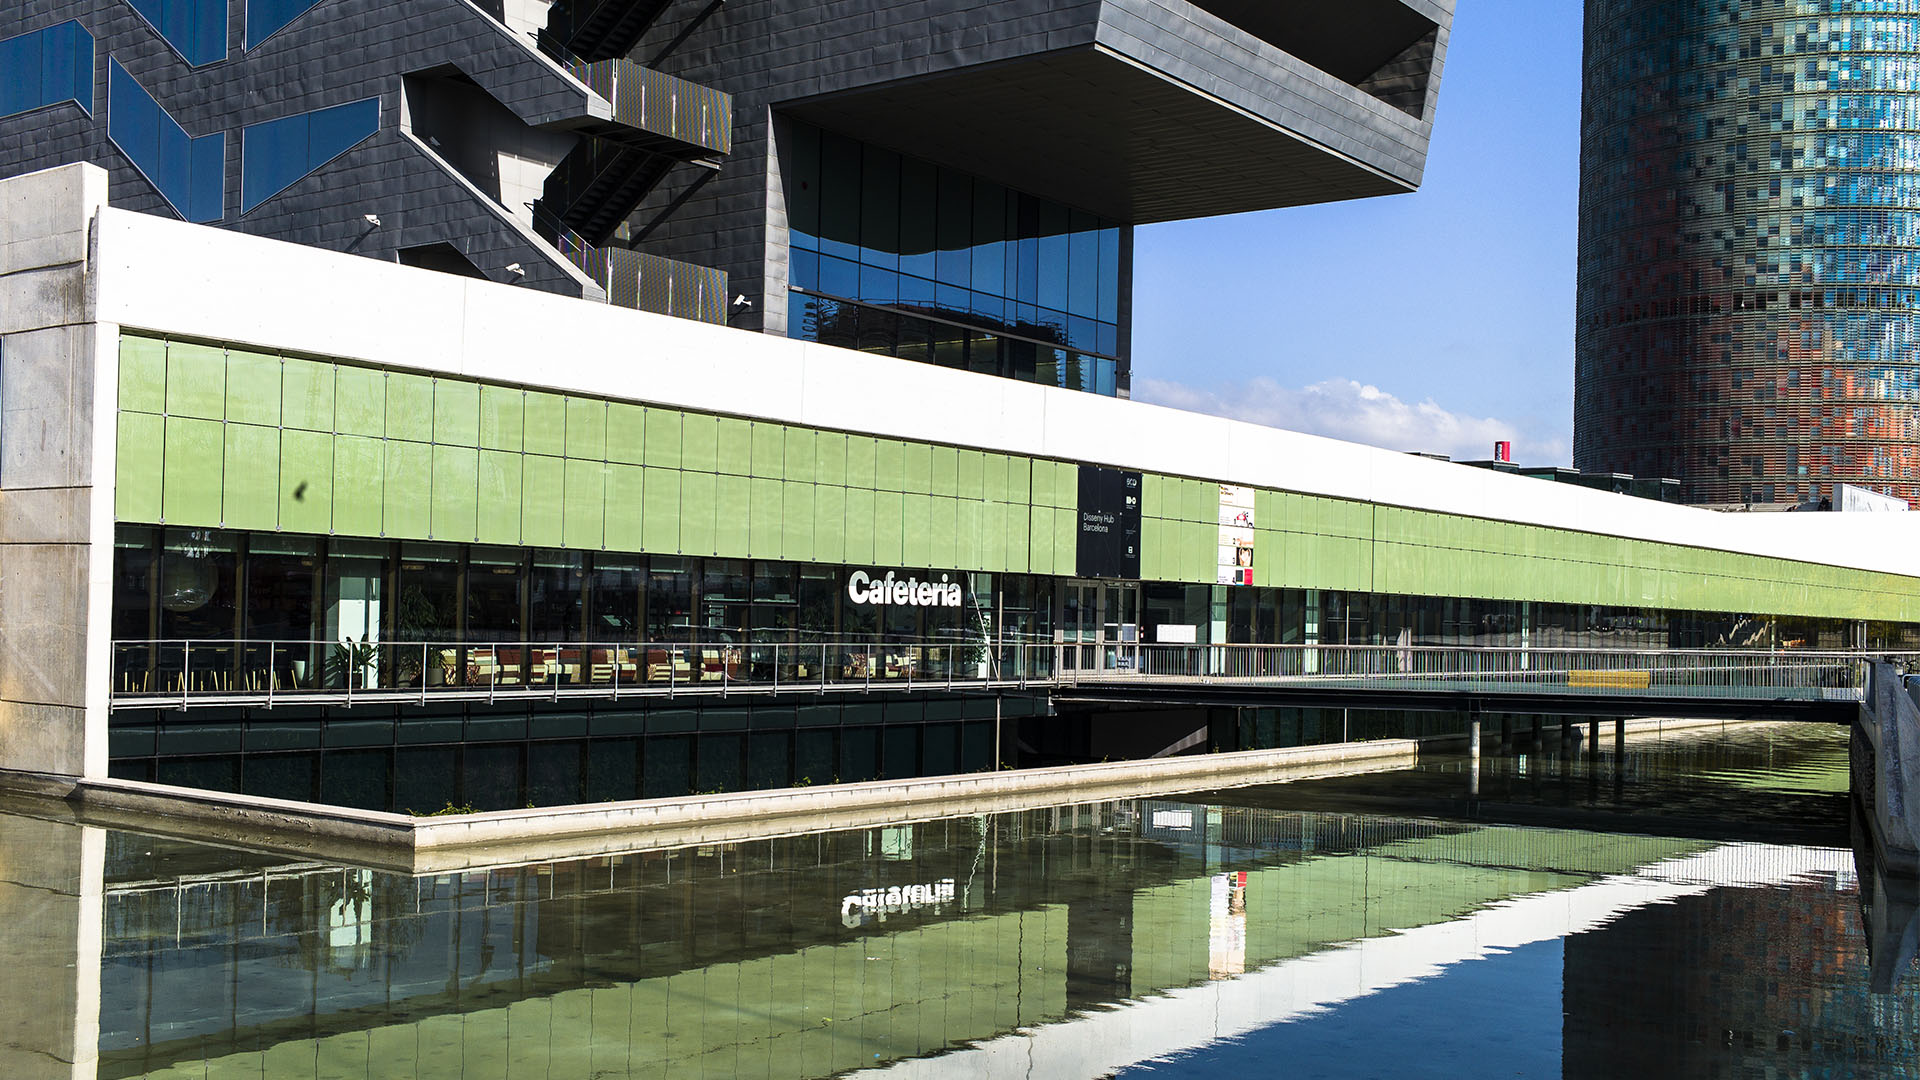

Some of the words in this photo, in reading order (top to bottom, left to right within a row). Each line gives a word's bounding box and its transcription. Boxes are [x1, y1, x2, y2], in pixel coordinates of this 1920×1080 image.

[1084, 512, 1103, 524] Disseny
[1104, 514, 1115, 524] Hub
[1083, 522, 1109, 533] Barcelona
[848, 570, 962, 607] Cafeteria
